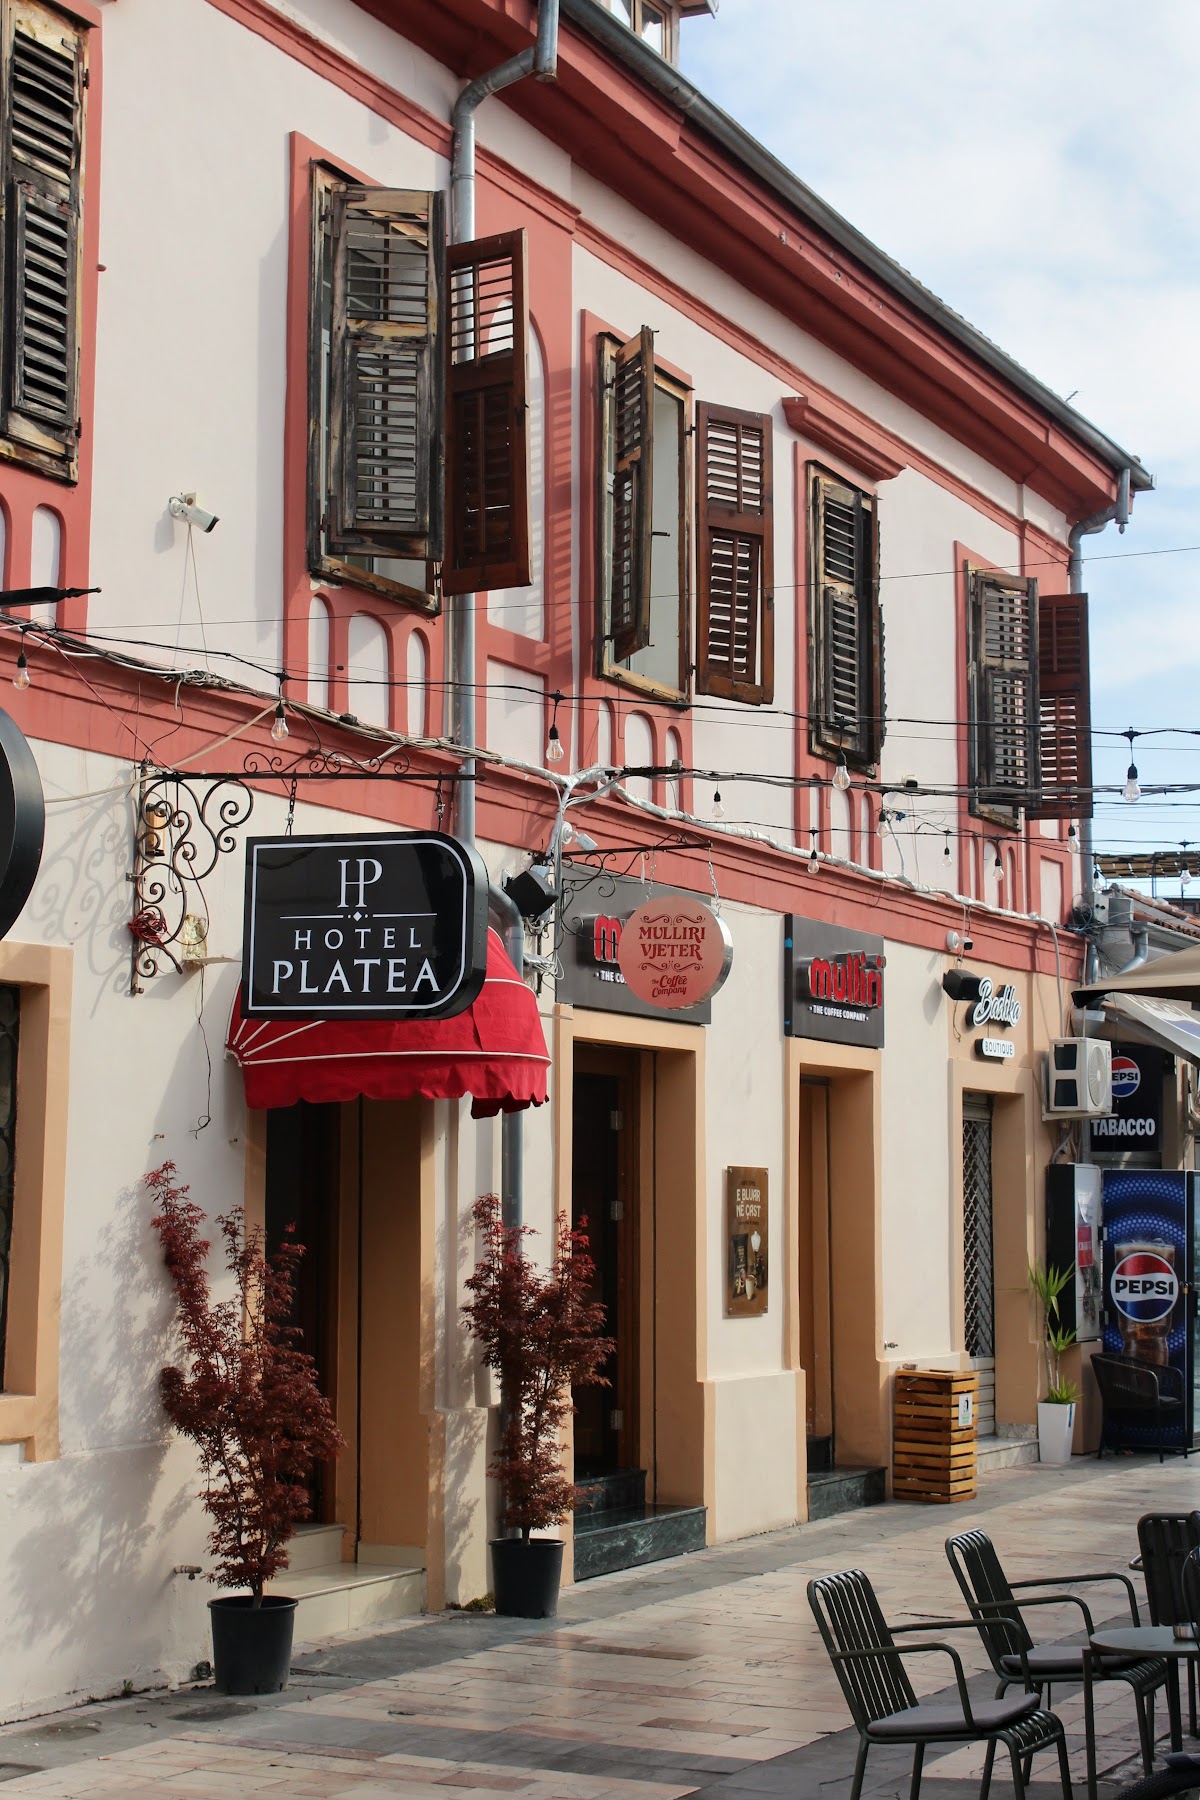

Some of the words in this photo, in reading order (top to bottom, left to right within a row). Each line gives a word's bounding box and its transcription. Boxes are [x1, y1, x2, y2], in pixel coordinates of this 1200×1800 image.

[294, 927, 422, 950] HOTEL
[638, 926, 706, 943] MULLIRI
[640, 943, 703, 961] VJETER
[271, 957, 442, 994] PLATEA
[600, 970, 615, 982] THE
[659, 974, 688, 988] Coffee
[809, 950, 884, 1009] mulliri
[651, 986, 688, 998] Company
[812, 1004, 823, 1014] THE
[824, 1006, 842, 1017] COFFEE
[843, 1010, 866, 1021] COMPANY
[985, 1041, 1013, 1055] BOUTIQUE
[1112, 1071, 1138, 1081] EPSI
[1091, 1118, 1156, 1136] TABACCO
[737, 1188, 741, 1201] E
[1115, 1279, 1174, 1295] PEPSI
